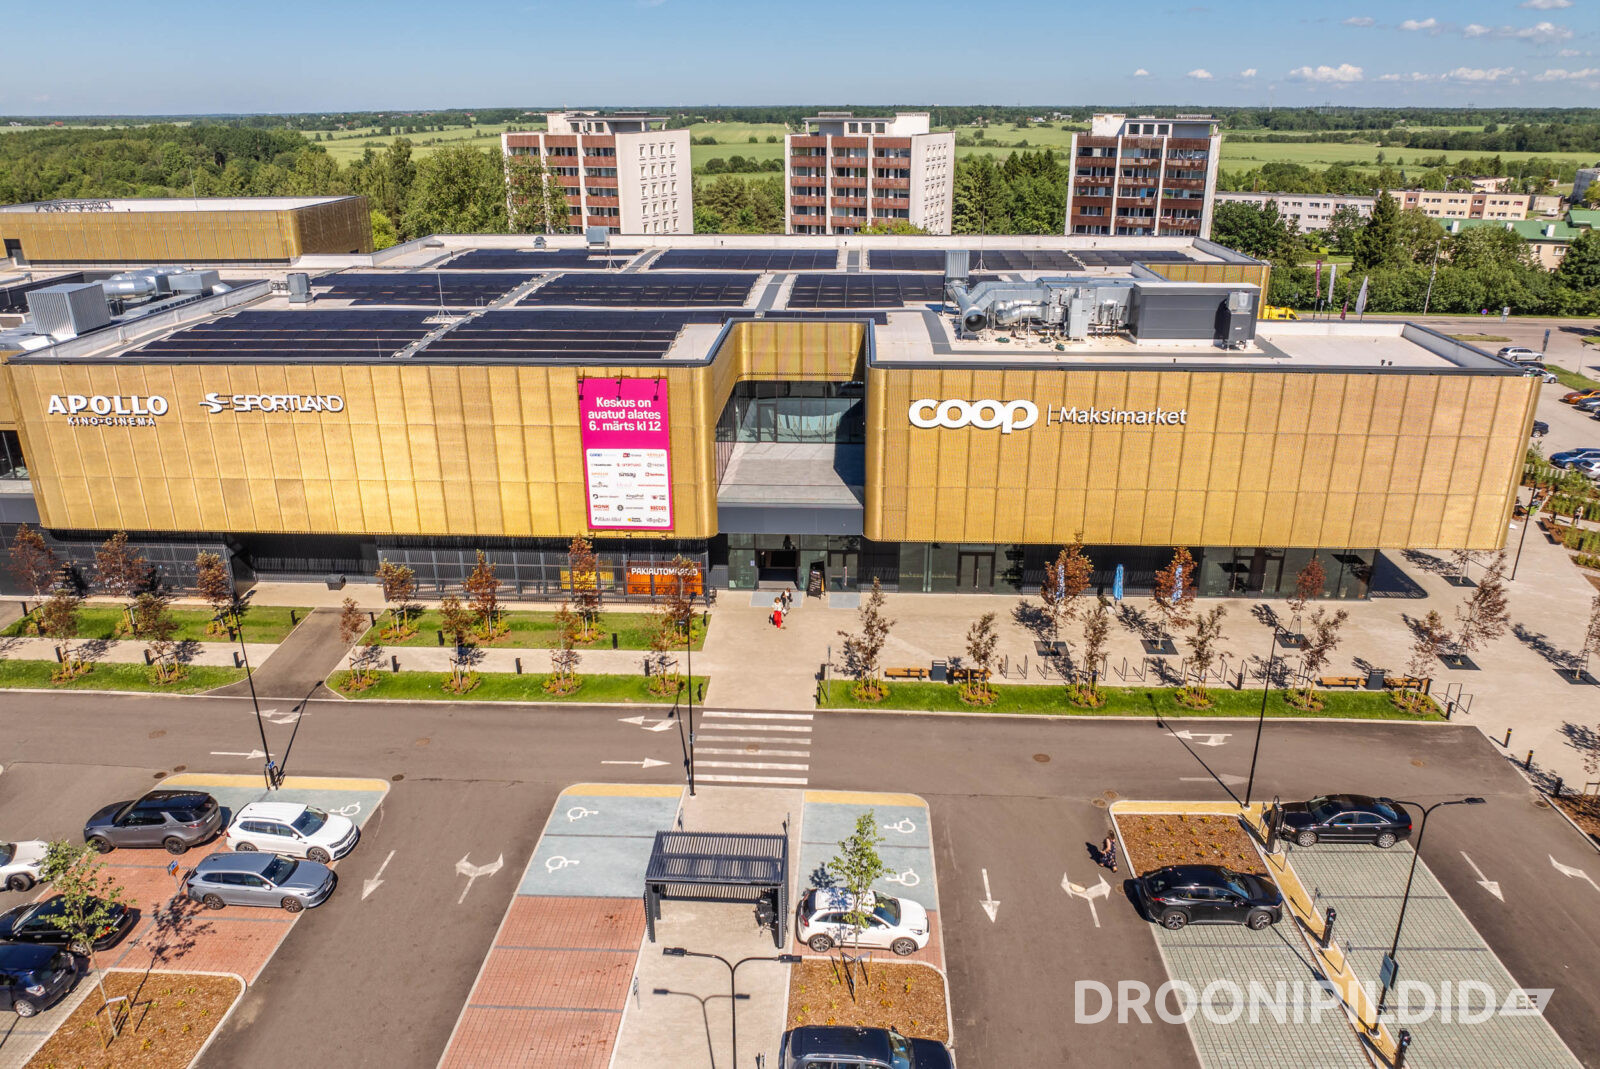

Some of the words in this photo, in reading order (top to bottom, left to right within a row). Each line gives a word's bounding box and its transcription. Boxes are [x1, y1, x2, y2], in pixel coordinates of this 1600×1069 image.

[48, 394, 168, 415] APOLLO
[232, 395, 344, 412] SPORTLAND
[596, 397, 635, 407] Keskus
[637, 399, 652, 407] on
[588, 409, 625, 419] avatud
[627, 409, 661, 419] alates
[1059, 406, 1187, 424] Maksimarket
[589, 420, 600, 431] 6.
[602, 420, 635, 431] märts
[636, 420, 647, 431] kl
[648, 421, 661, 431] 12
